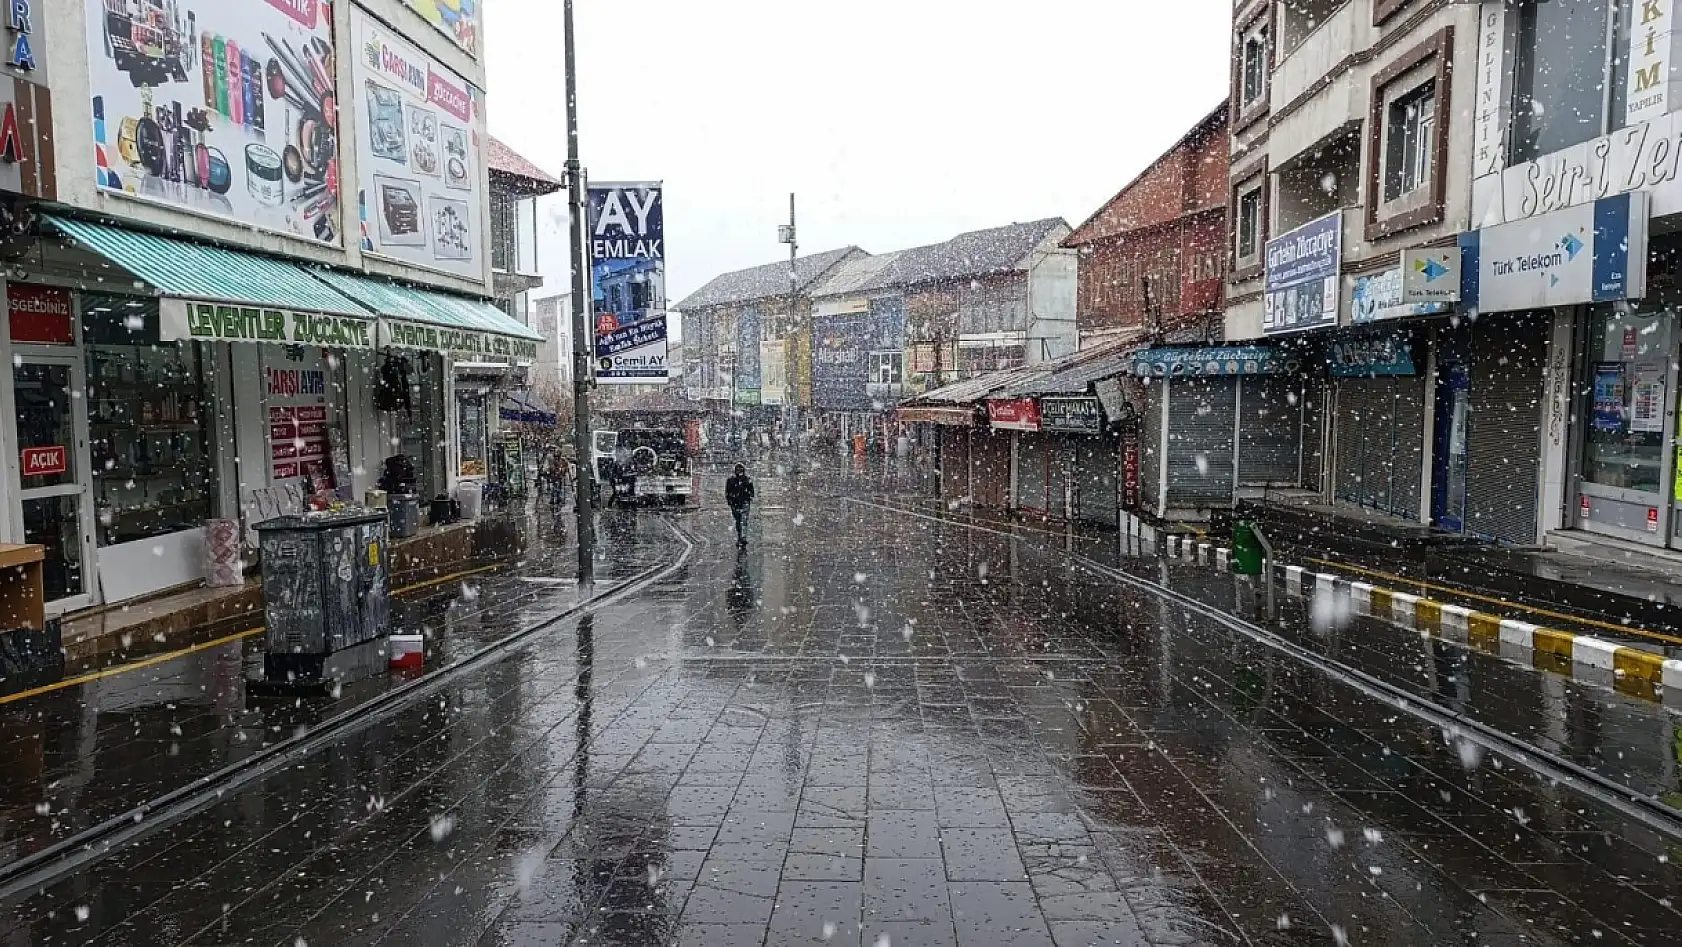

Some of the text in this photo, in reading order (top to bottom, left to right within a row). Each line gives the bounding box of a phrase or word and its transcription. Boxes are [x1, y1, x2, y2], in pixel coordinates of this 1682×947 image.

[1628, 94, 1663, 113] YAPILIR
[595, 191, 659, 236] AY
[594, 240, 661, 258] EMLAK
[1493, 252, 1562, 276] Türk Telekom
[187, 303, 286, 341] LEVENTLER
[388, 322, 439, 349] LEVENTLER
[615, 355, 664, 366] Cemil AY
[30, 452, 60, 469] AÇIK
